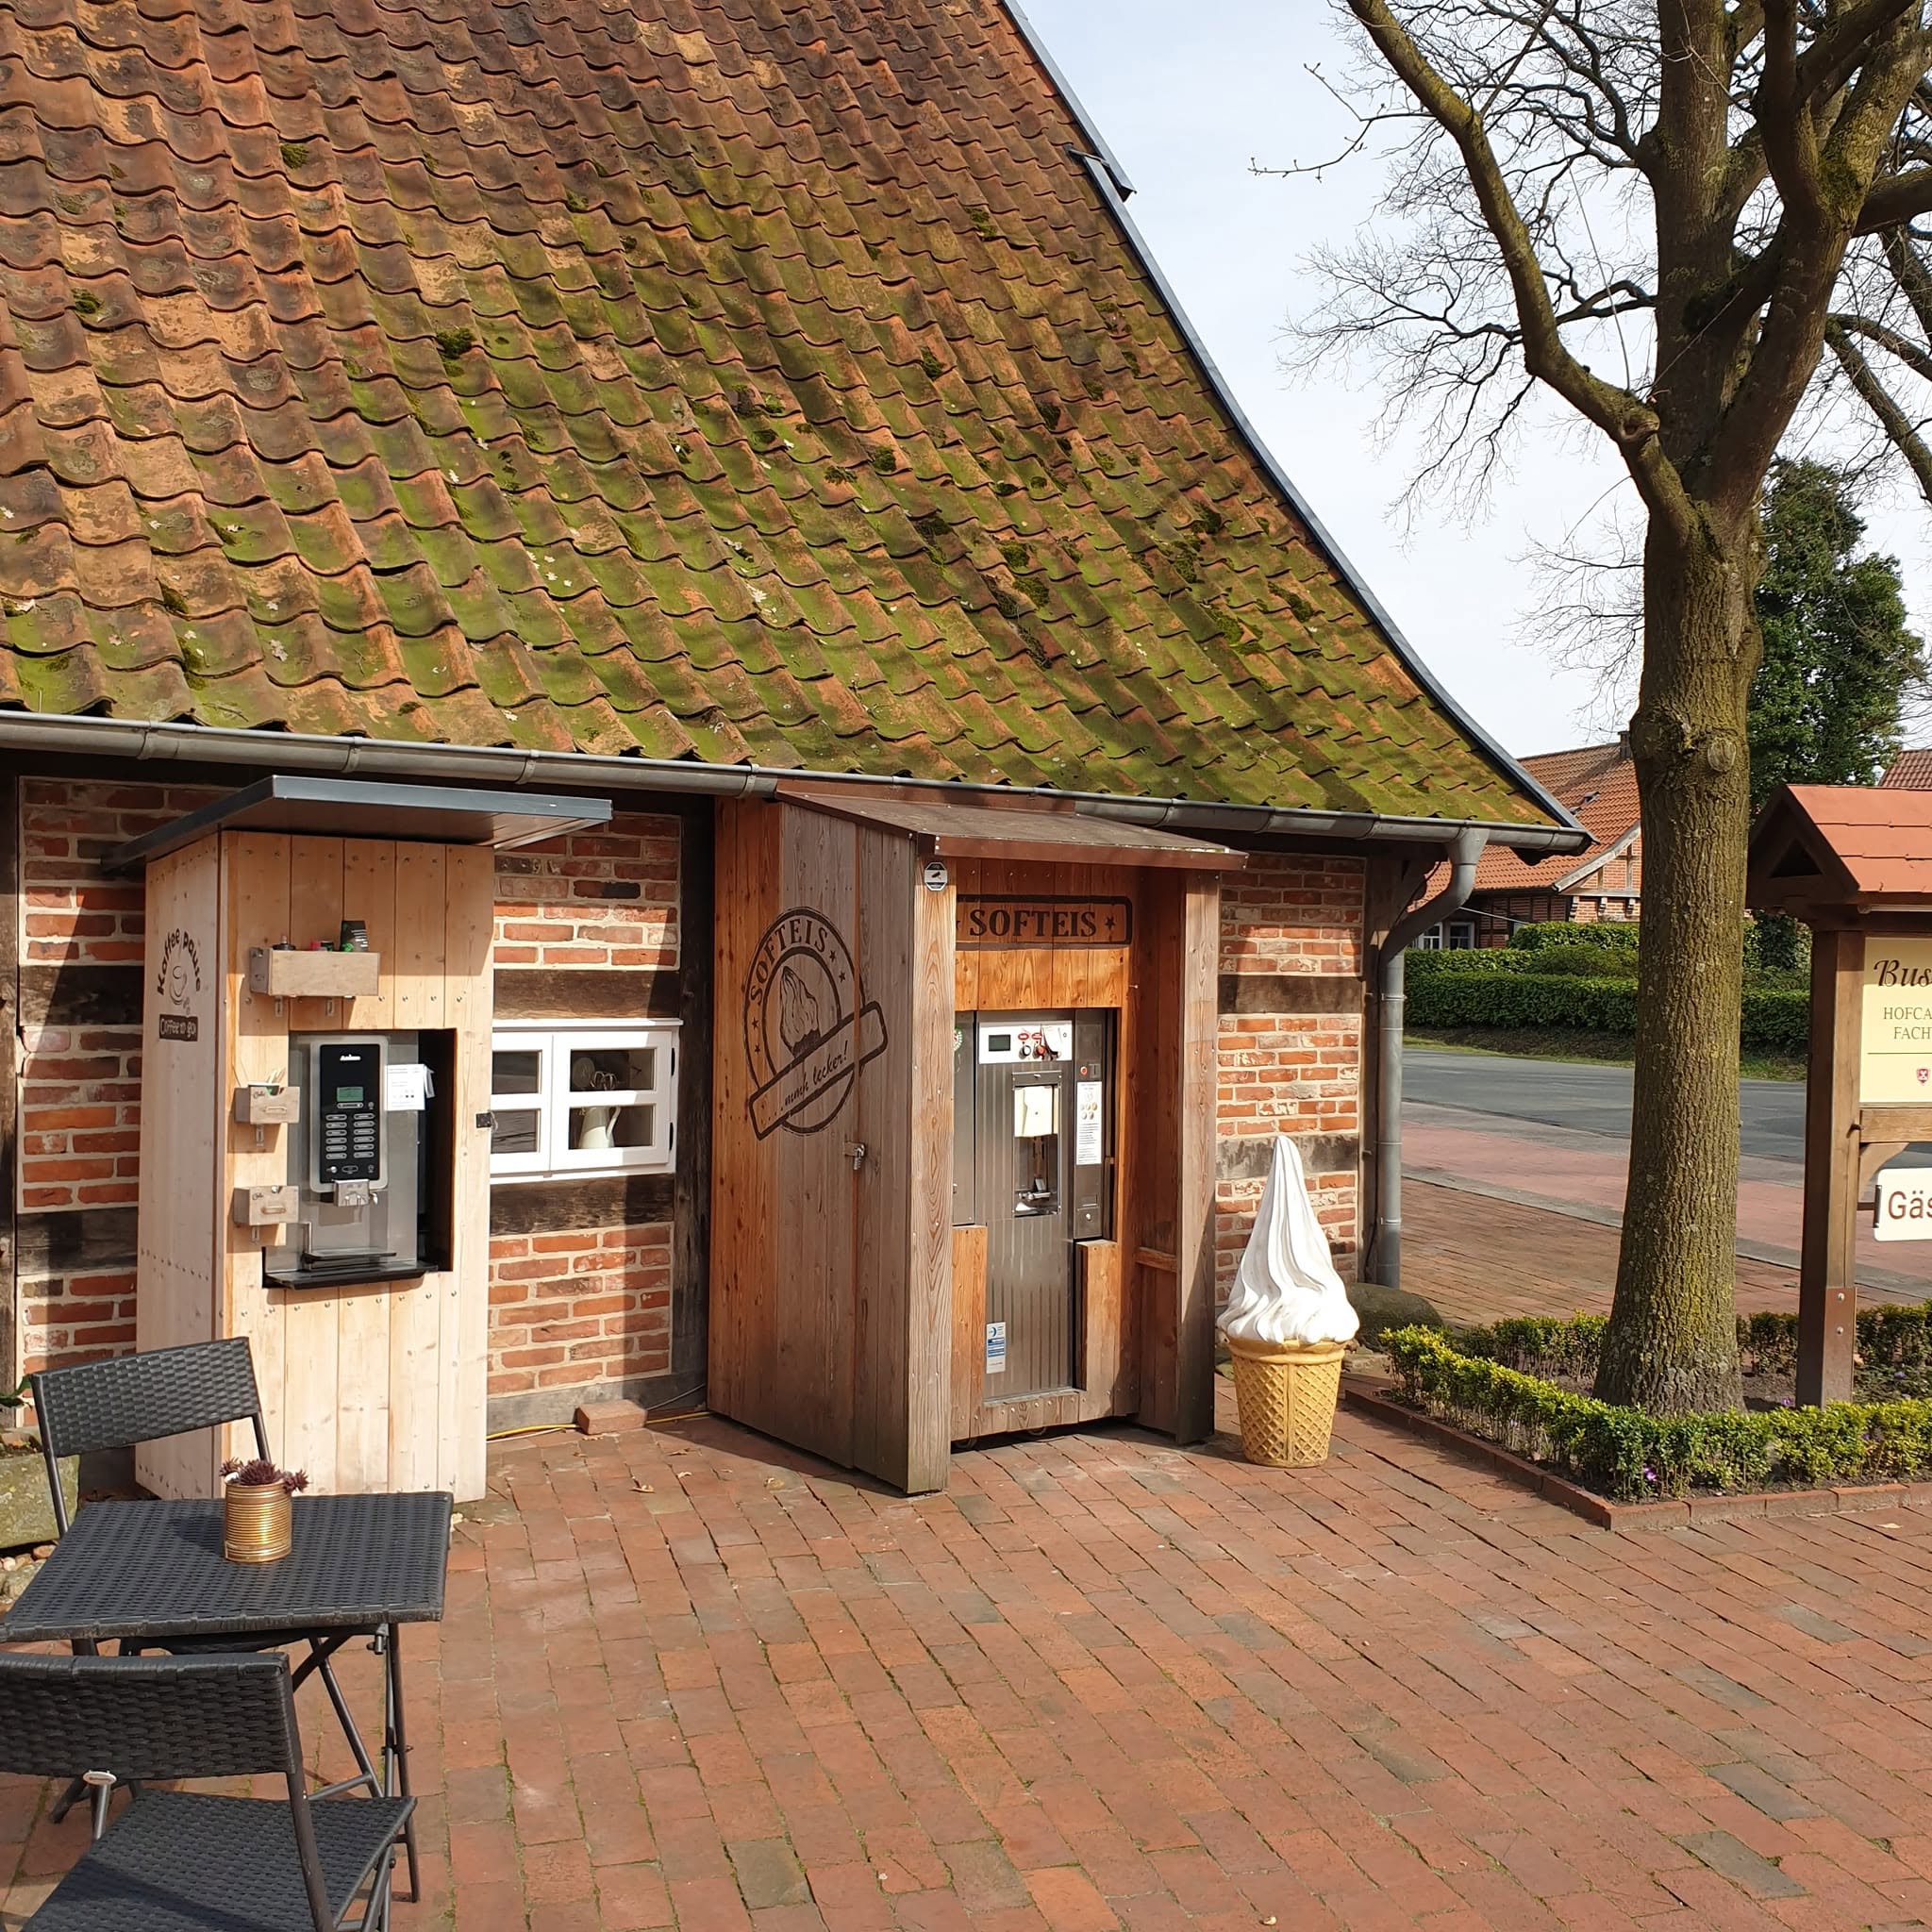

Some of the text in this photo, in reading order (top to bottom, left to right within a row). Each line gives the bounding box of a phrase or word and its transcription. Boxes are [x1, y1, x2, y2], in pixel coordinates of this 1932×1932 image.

[970, 909, 1096, 937] SOFTEIS
[157, 928, 180, 995] Kaffee
[750, 918, 828, 1007] SOFTEIS
[1883, 1007, 1932, 1020] HOFCA
[1893, 1026, 1932, 1040] FACH
[813, 1040, 848, 1085] lecker!
